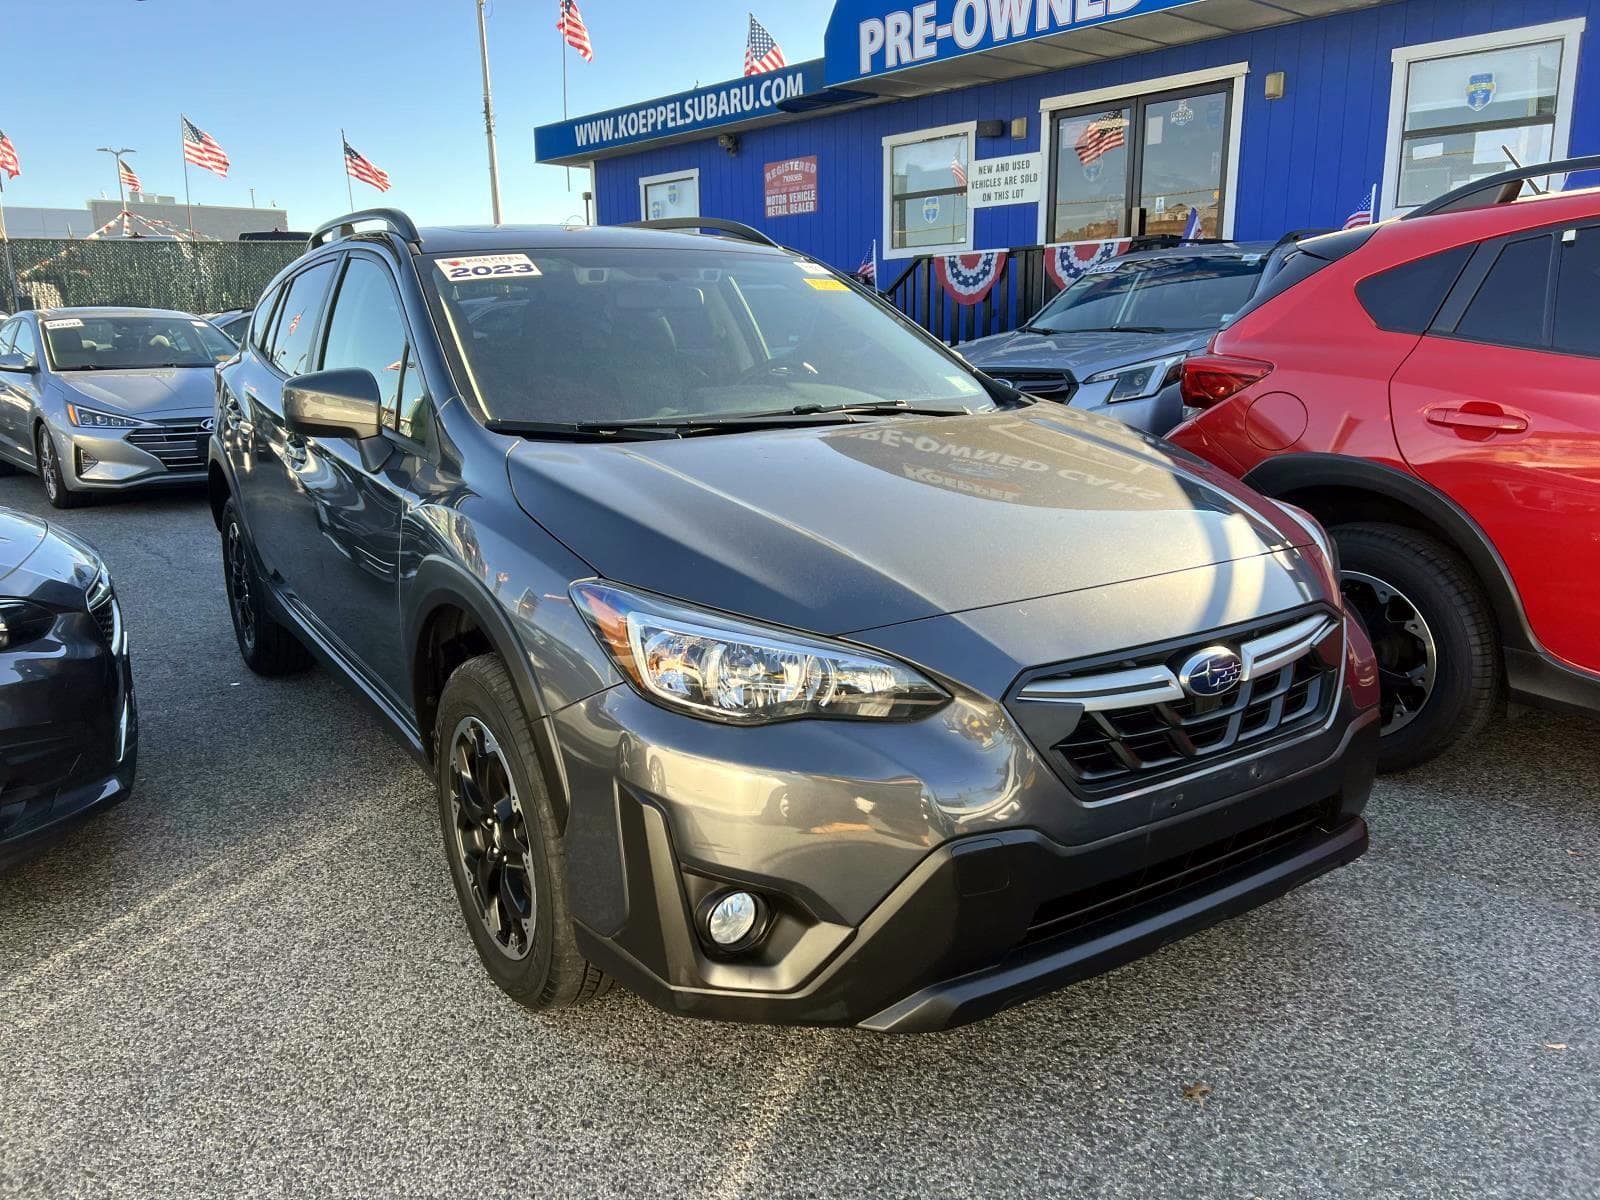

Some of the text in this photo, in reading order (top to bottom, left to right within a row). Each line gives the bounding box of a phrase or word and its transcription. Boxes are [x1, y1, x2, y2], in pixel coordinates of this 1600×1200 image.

[859, 0, 1142, 75] PRE-OWN
[575, 73, 804, 147] WWW.KOEPPELSUBARU.COM
[766, 160, 816, 182] REGISTERED
[978, 160, 1030, 175] NEW AND USED
[971, 173, 1038, 190] VEHICLES ARE SOLD
[766, 190, 816, 206] MOTOR VEHICLE
[982, 189, 1025, 202] ON THIS LOT
[767, 201, 815, 217] RETAIL DEALER
[449, 264, 534, 278] 2023
